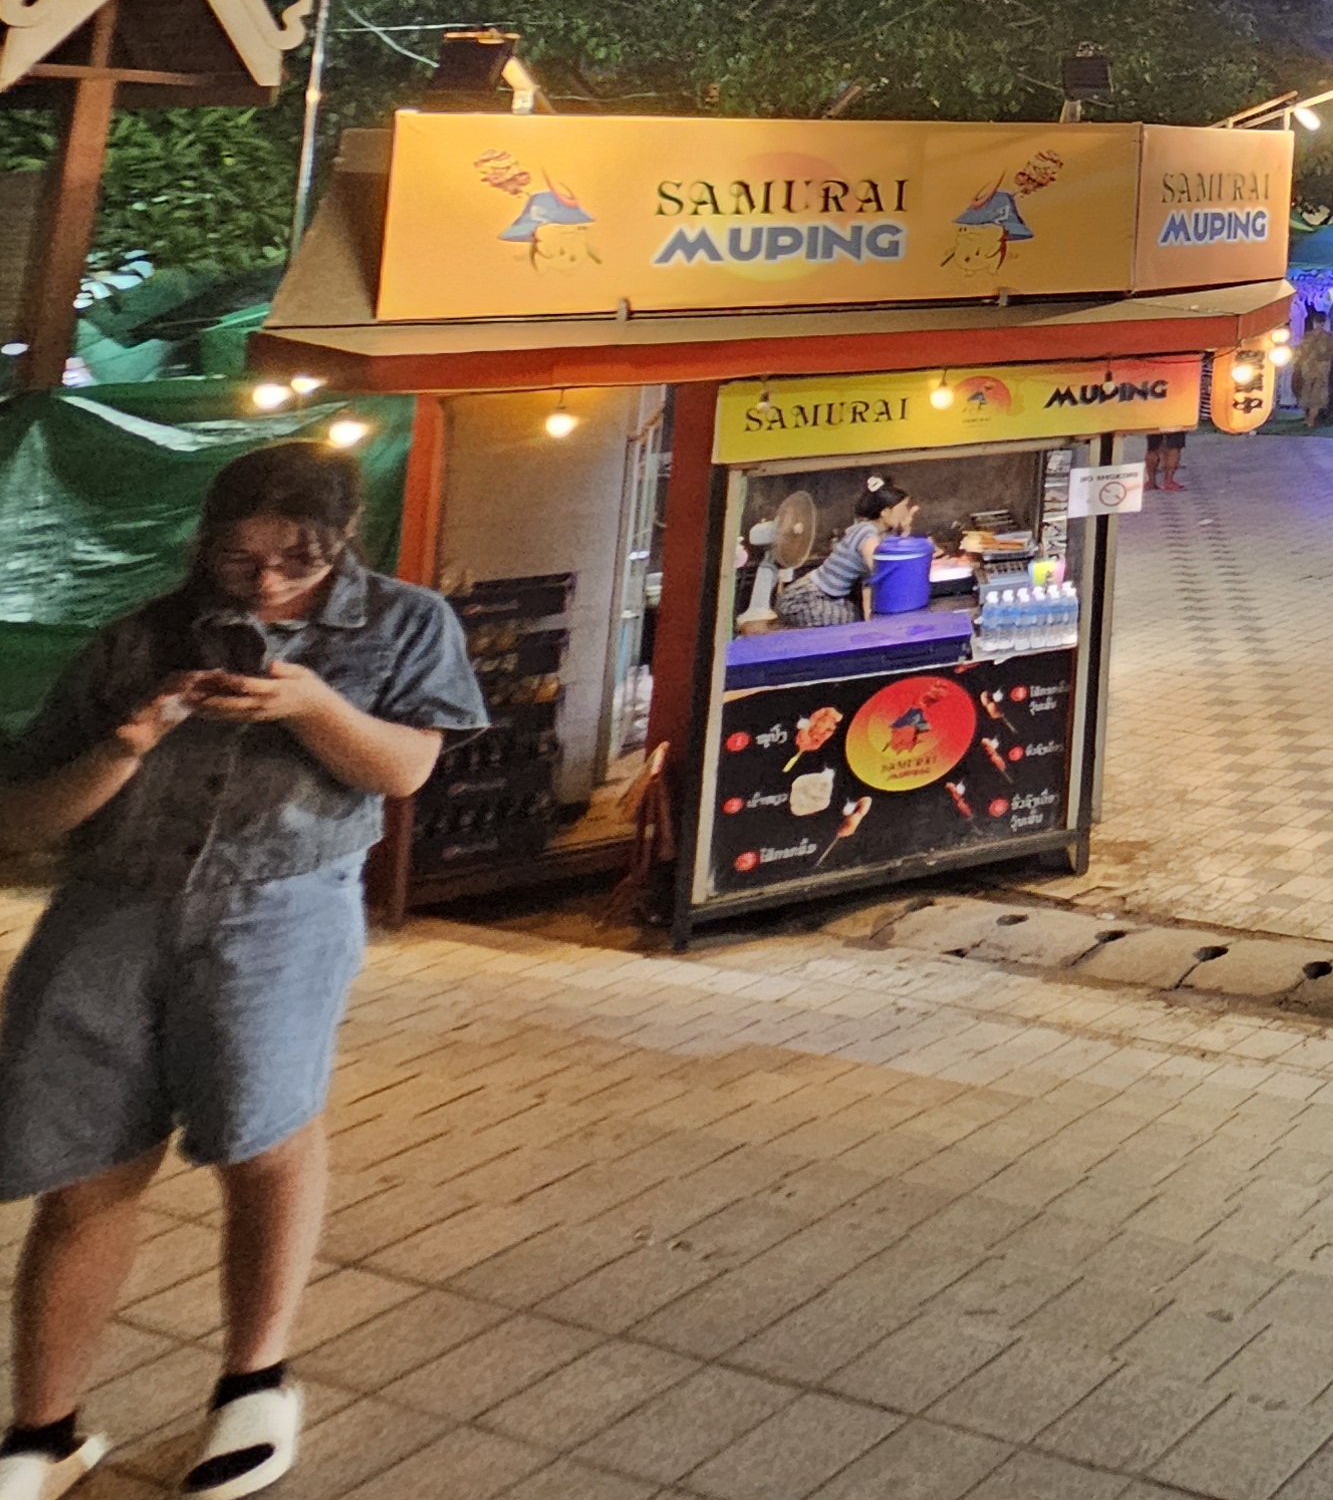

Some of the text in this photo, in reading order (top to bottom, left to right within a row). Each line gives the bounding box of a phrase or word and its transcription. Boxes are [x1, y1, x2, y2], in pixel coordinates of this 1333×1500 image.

[654, 179, 910, 216] SAMURAI
[1161, 171, 1270, 204] SAMURAI
[651, 222, 906, 265] MUPING
[1160, 209, 1268, 244] MUPING
[743, 396, 909, 433] SAMURAI
